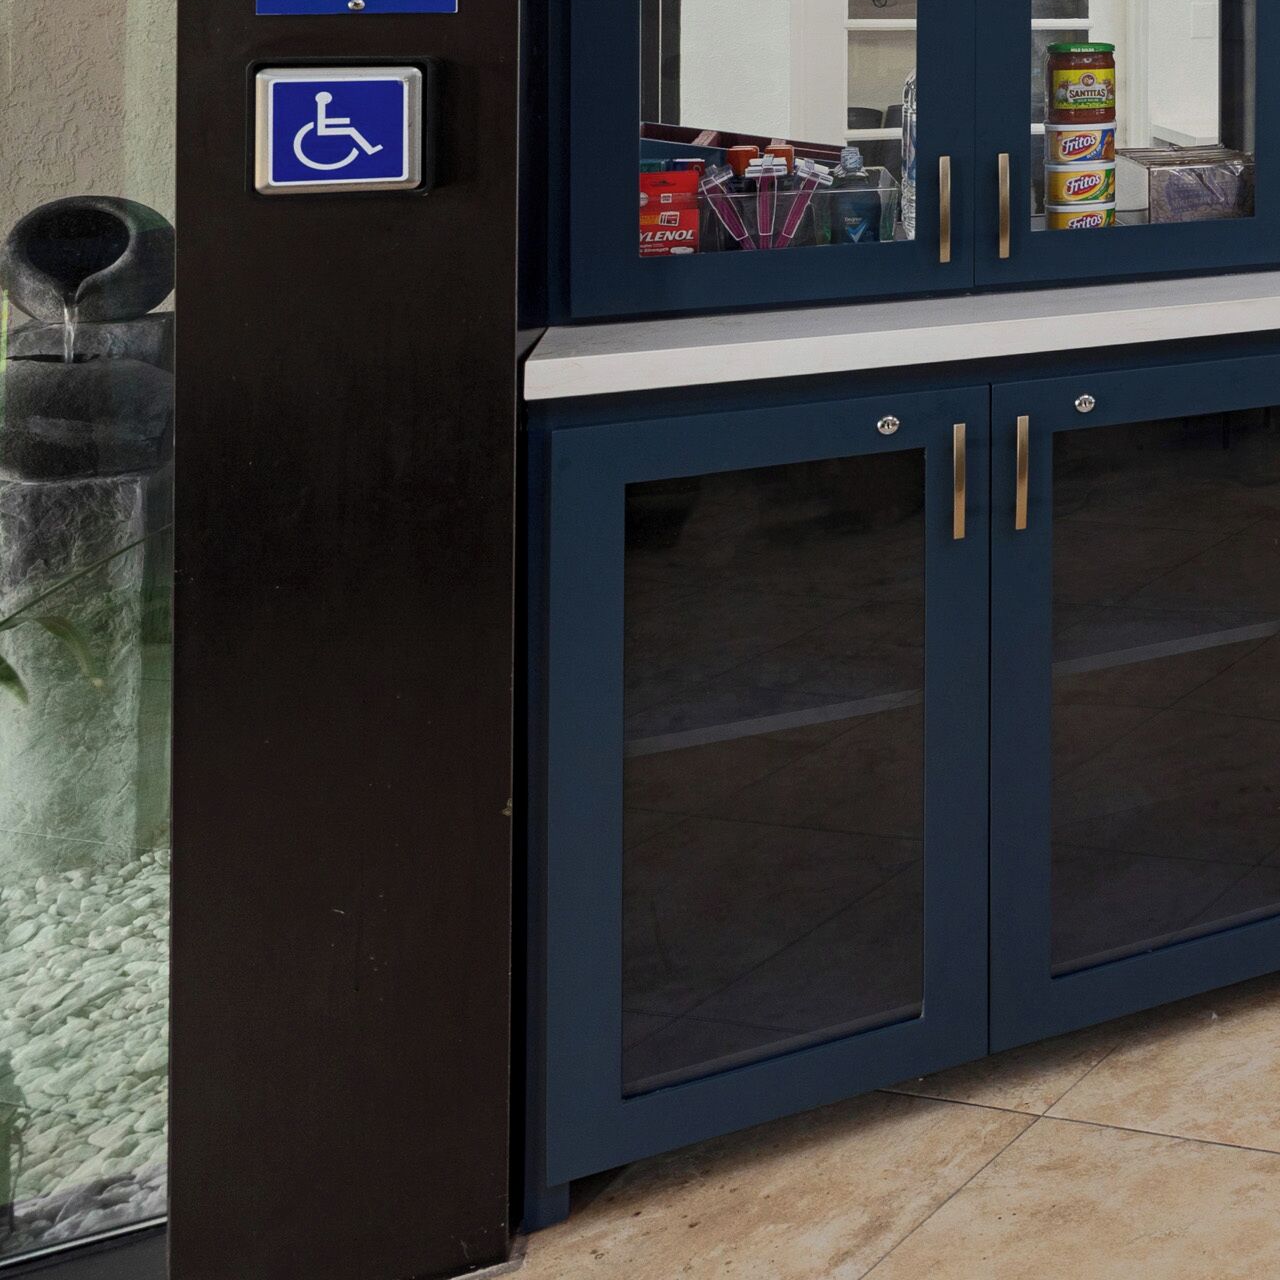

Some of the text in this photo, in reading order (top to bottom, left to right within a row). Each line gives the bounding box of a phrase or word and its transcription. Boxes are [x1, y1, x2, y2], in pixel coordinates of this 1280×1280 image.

[1069, 88, 1106, 99] SANTITAS
[1062, 135, 1097, 155] Fritos
[1066, 175, 1100, 194] Fritos
[640, 230, 695, 242] YLENOL
